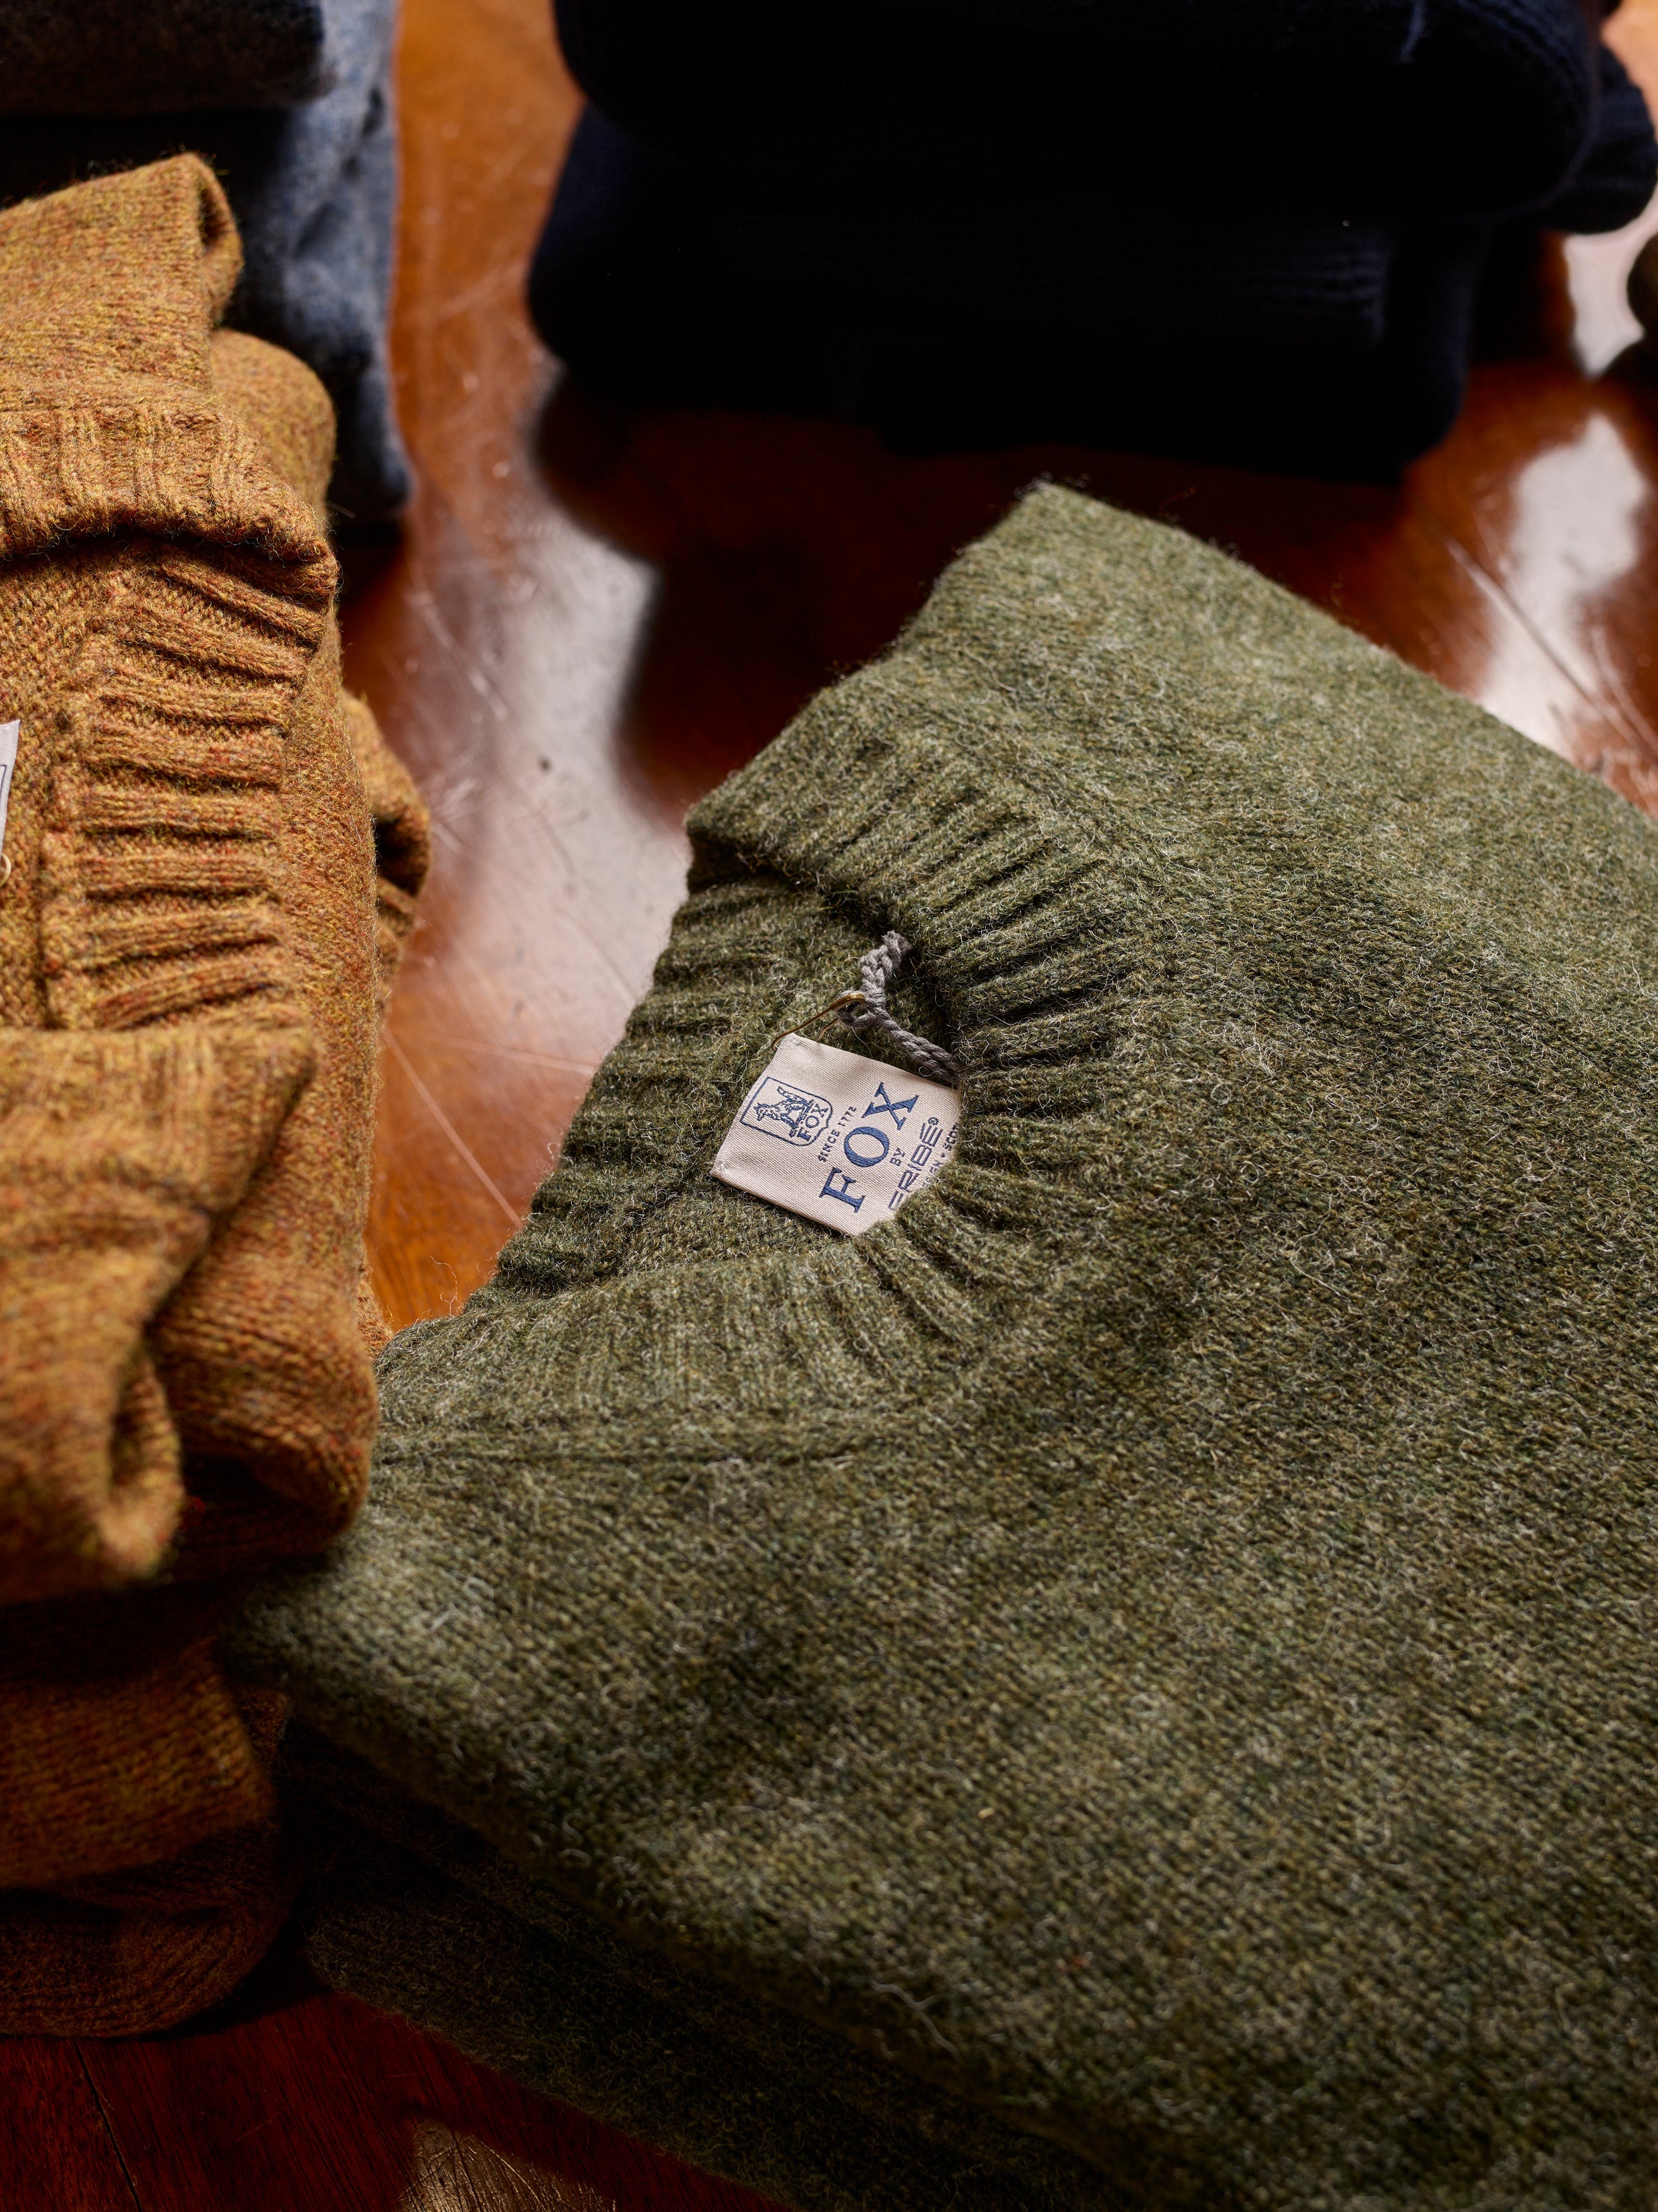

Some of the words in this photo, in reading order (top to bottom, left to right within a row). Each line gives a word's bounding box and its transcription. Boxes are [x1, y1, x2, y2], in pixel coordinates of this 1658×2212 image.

[797, 1103, 829, 1141] FOX
[943, 1122, 958, 1151] SCOT
[818, 1129, 840, 1162] SINCE
[819, 1081, 919, 1213] FOX
[890, 1148, 905, 1167] BY
